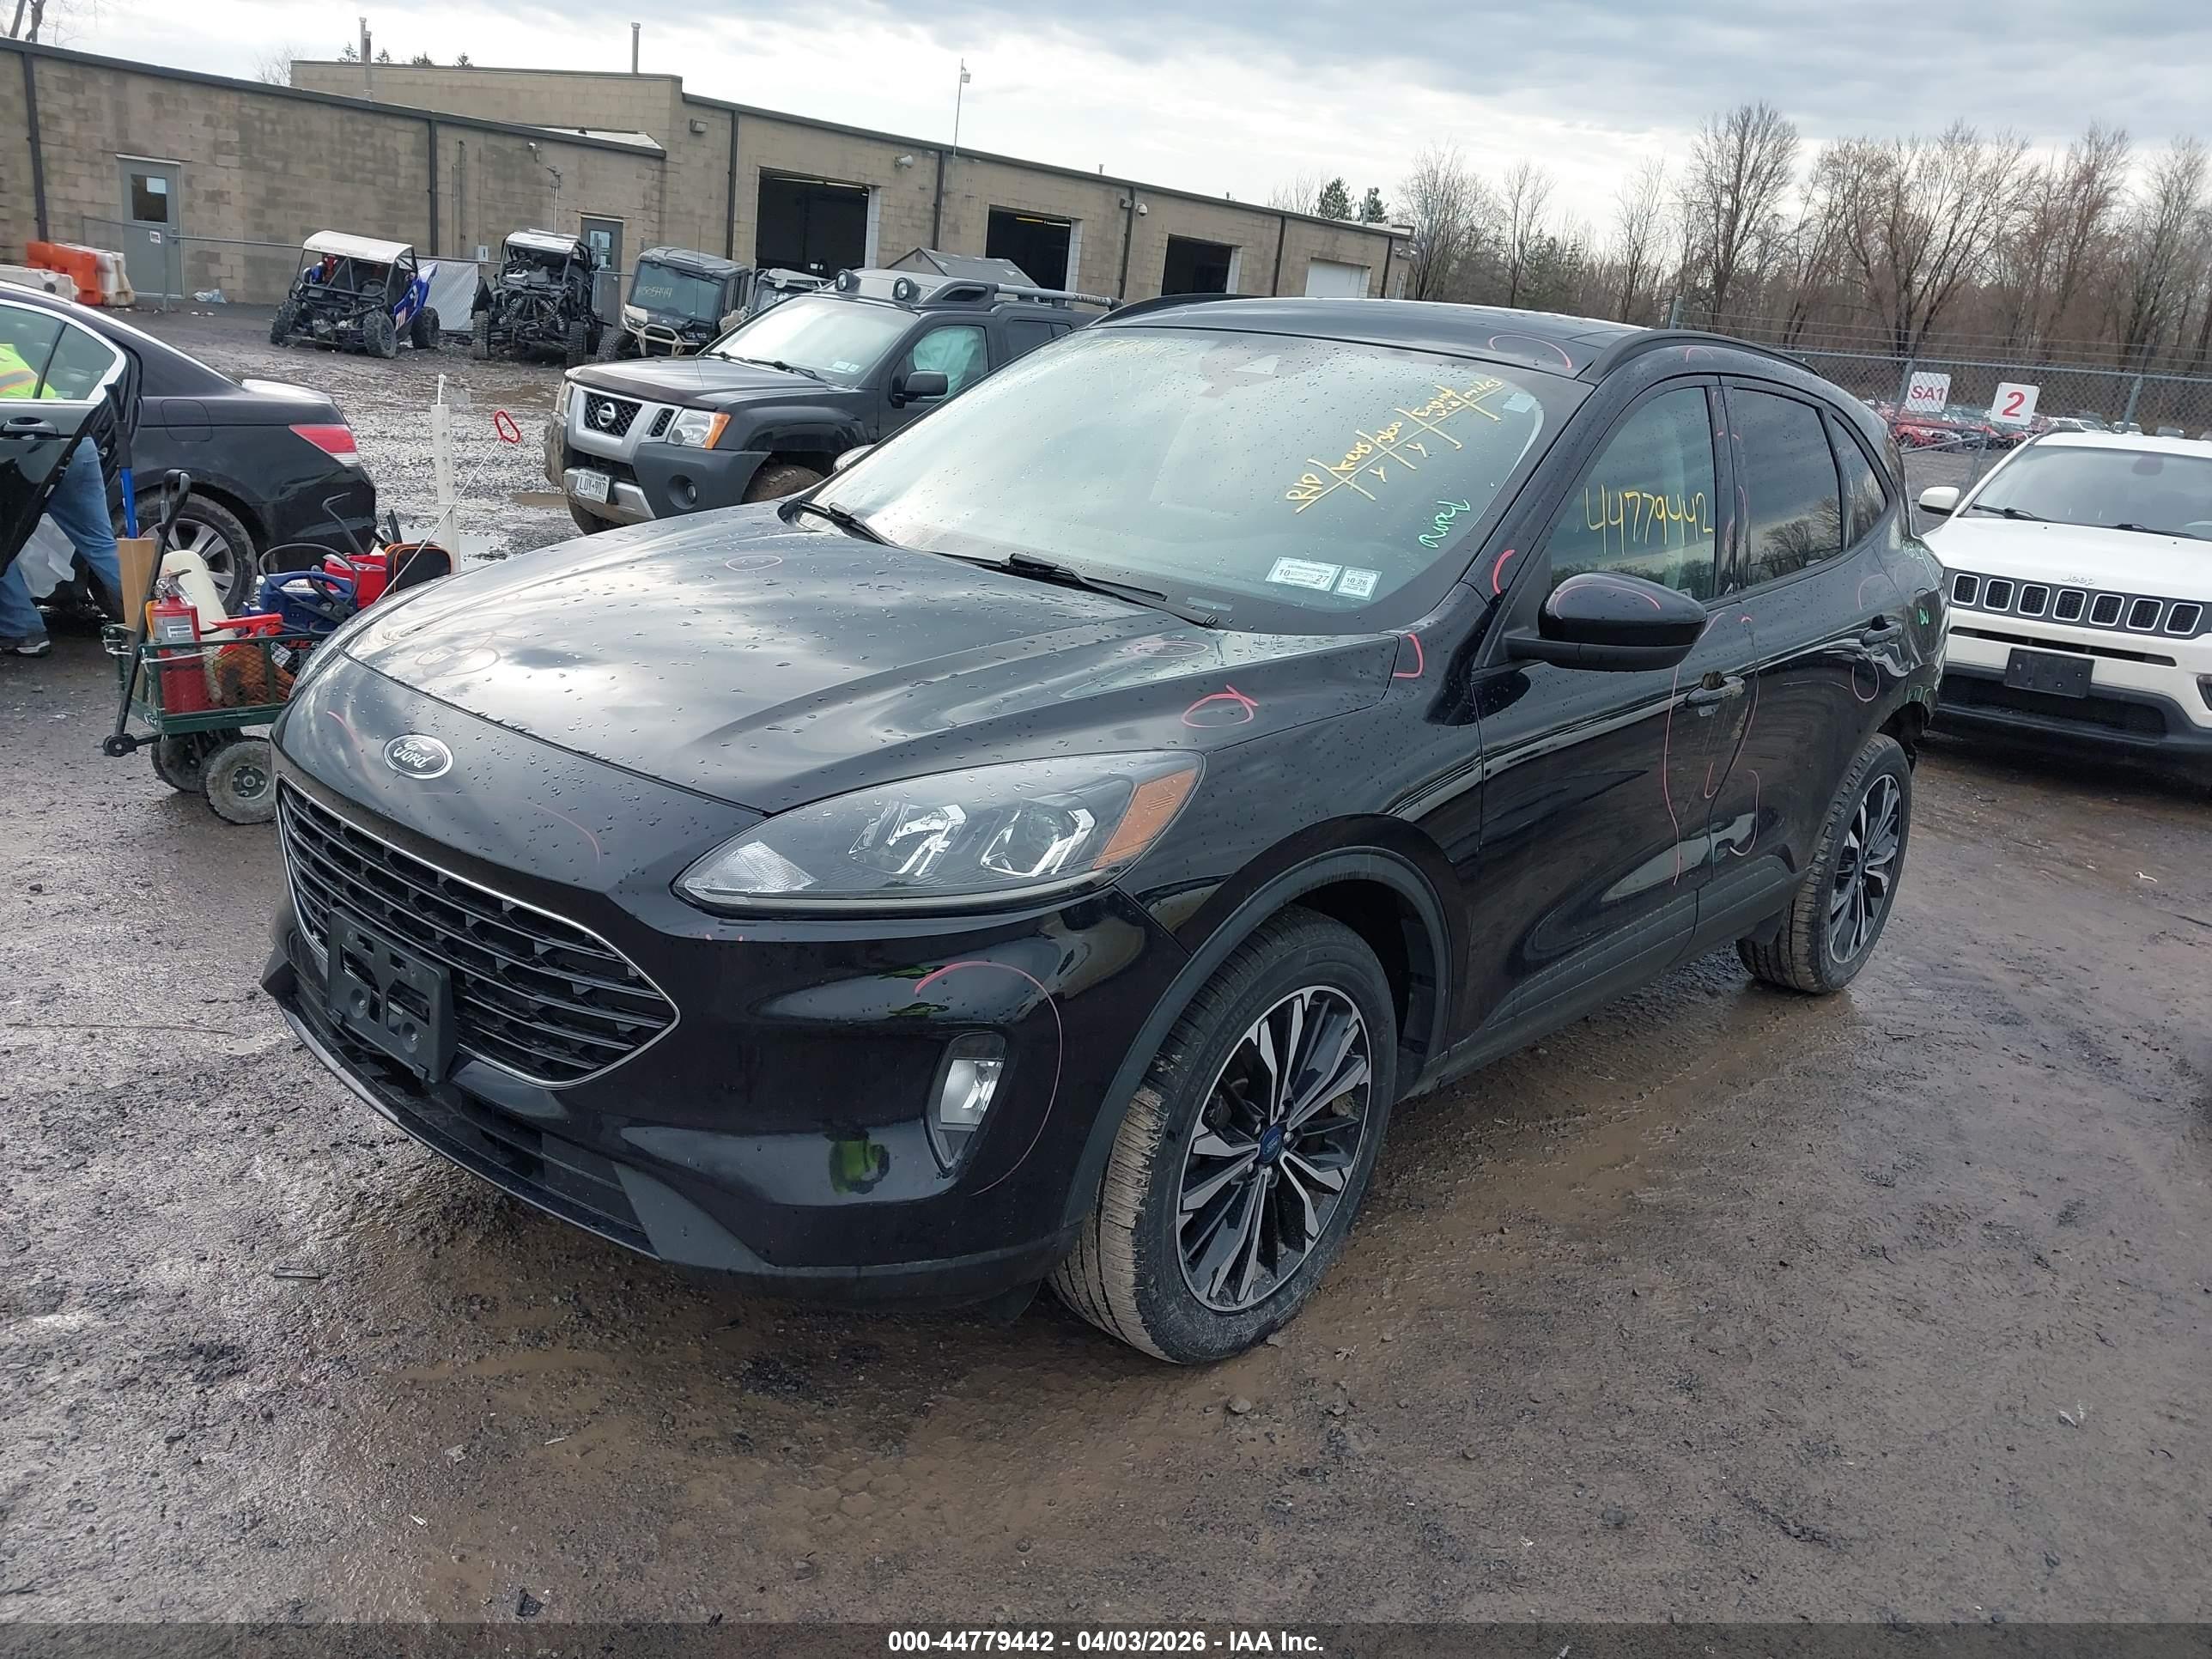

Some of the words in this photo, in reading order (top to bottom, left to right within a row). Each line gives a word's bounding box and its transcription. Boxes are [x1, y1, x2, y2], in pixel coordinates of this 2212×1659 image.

[1911, 385, 1946, 402] SA1
[2001, 391, 2027, 417] 2
[1585, 483, 1714, 556] 44779442
[1279, 568, 1291, 577] 10
[1315, 574, 1330, 583] 27
[2060, 573, 2096, 586] Jeep
[392, 740, 436, 769] Ford
